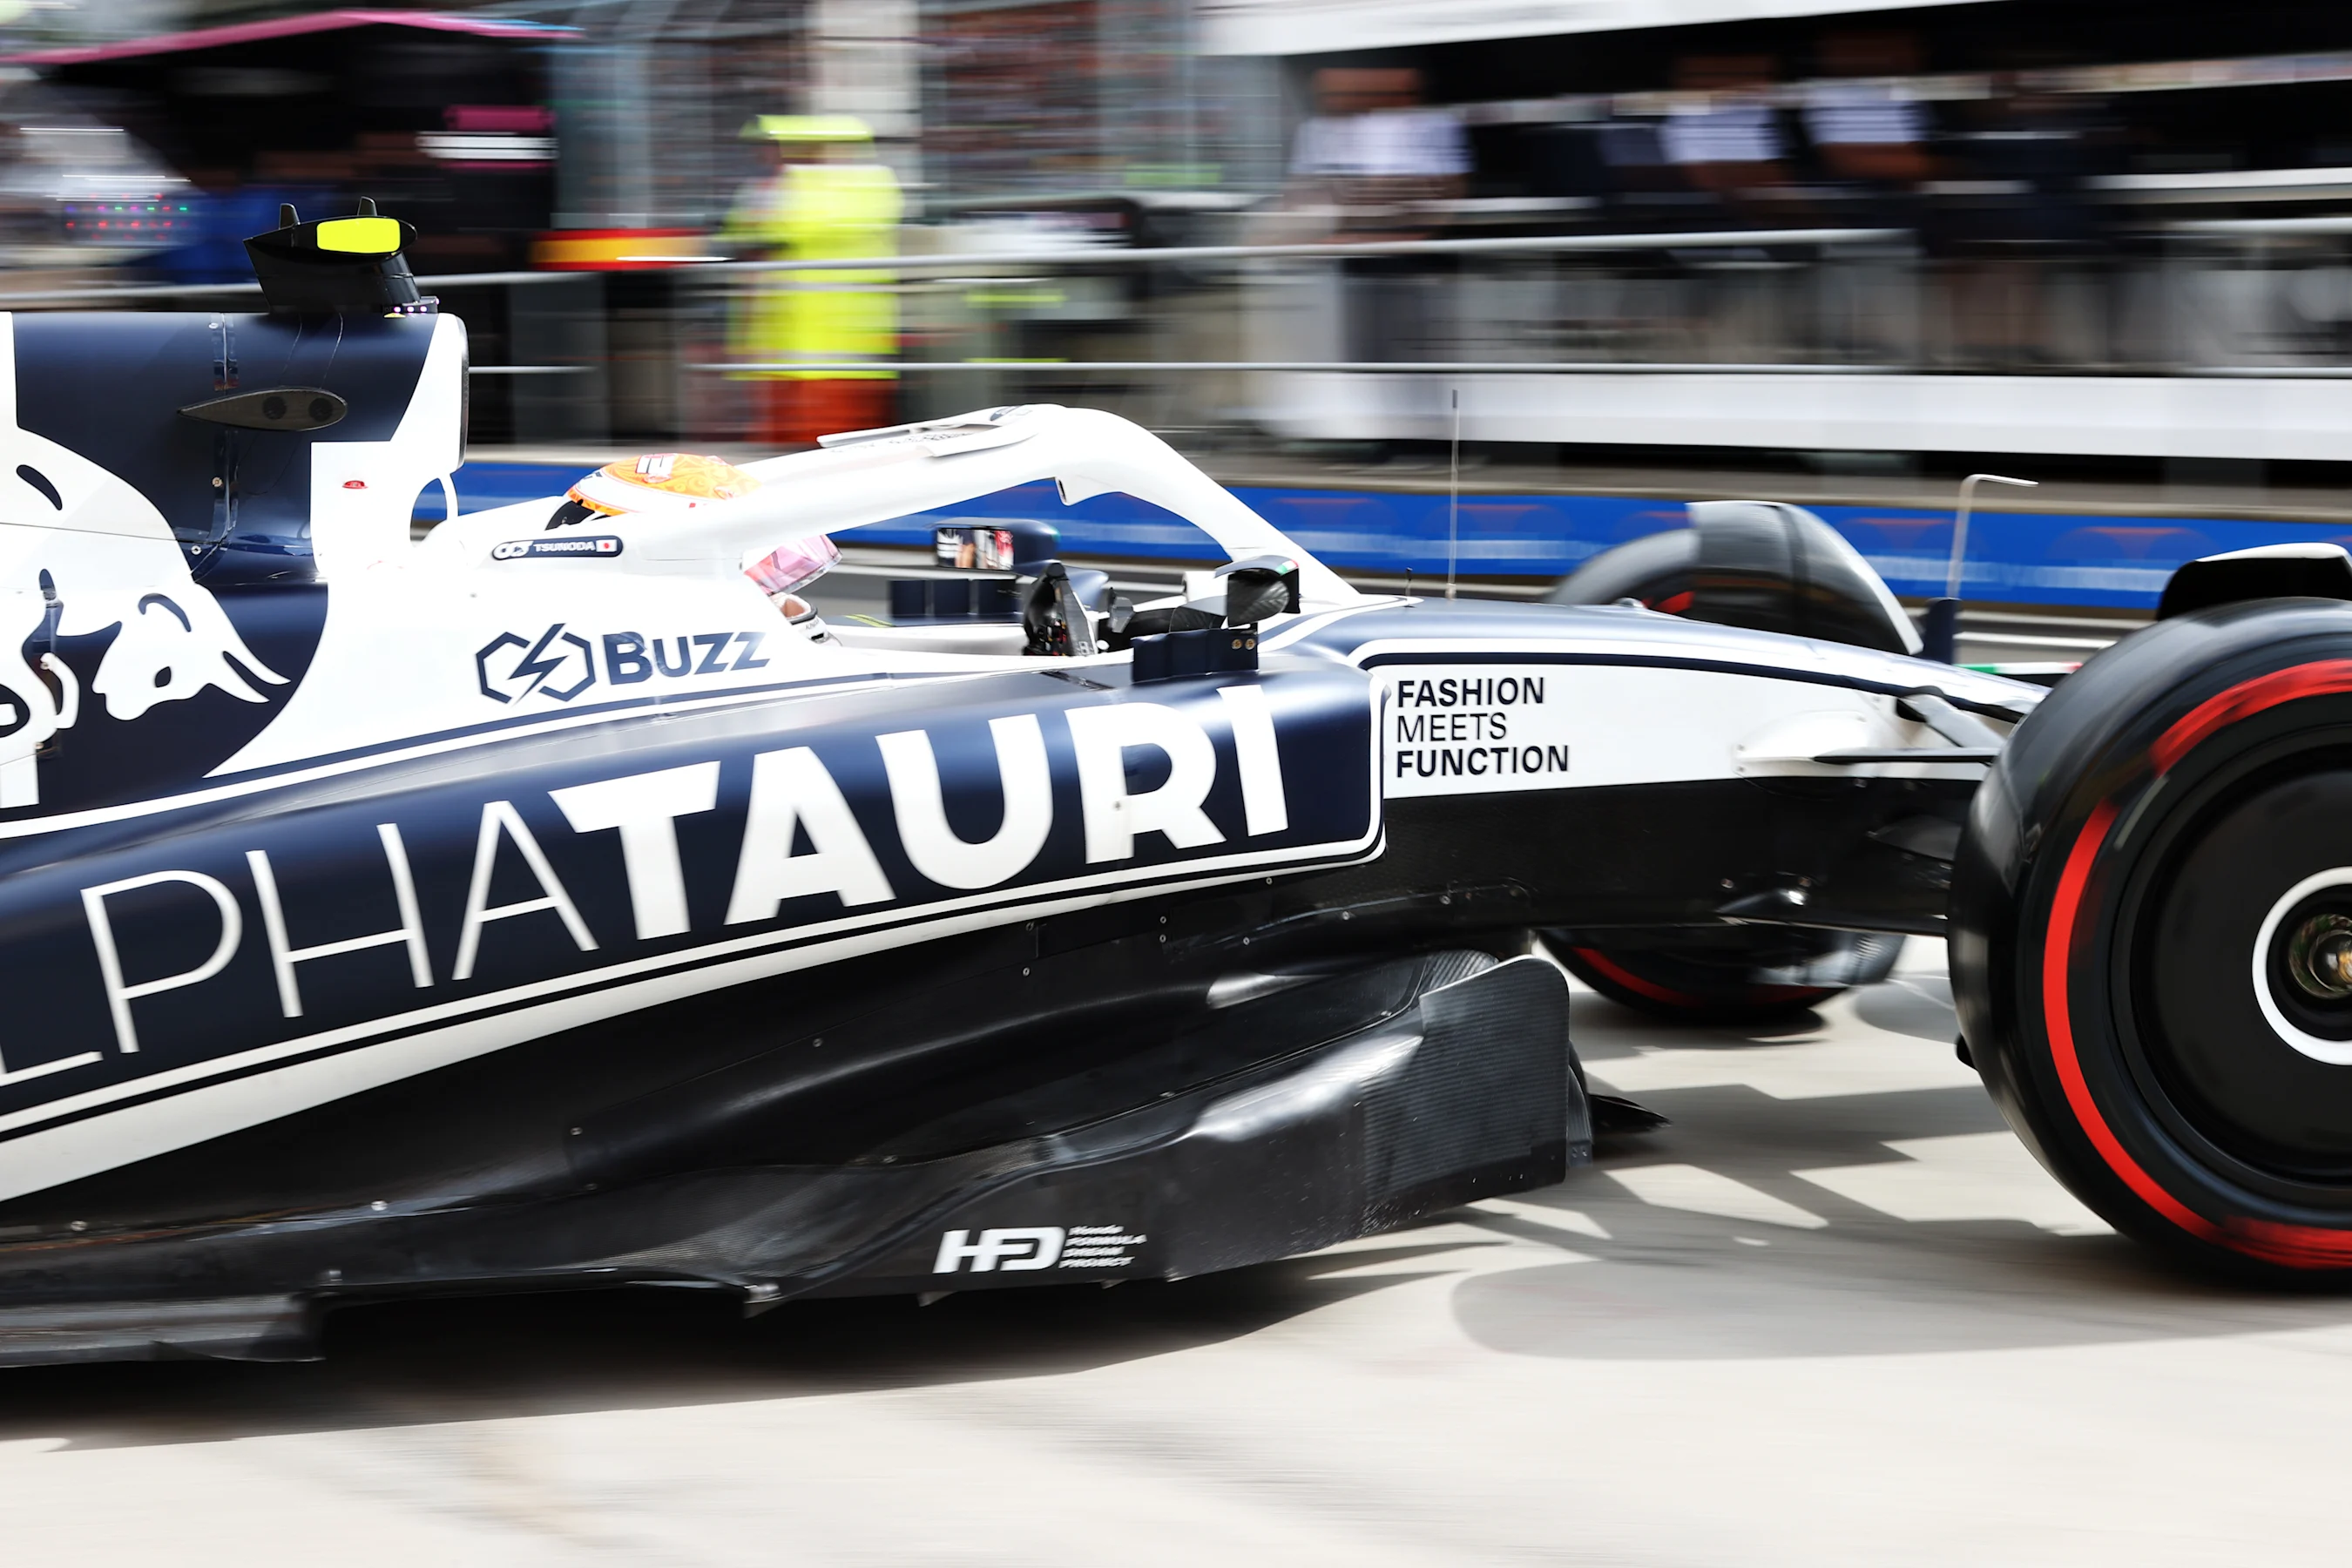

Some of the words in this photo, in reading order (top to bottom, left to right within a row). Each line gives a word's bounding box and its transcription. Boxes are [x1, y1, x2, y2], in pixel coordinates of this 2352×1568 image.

[532, 540, 596, 552] TSUNODA
[602, 632, 771, 686] BUZZ
[1397, 677, 1544, 707] FASHION
[1397, 712, 1507, 742] MEETS
[1396, 745, 1569, 778] FUNCTION
